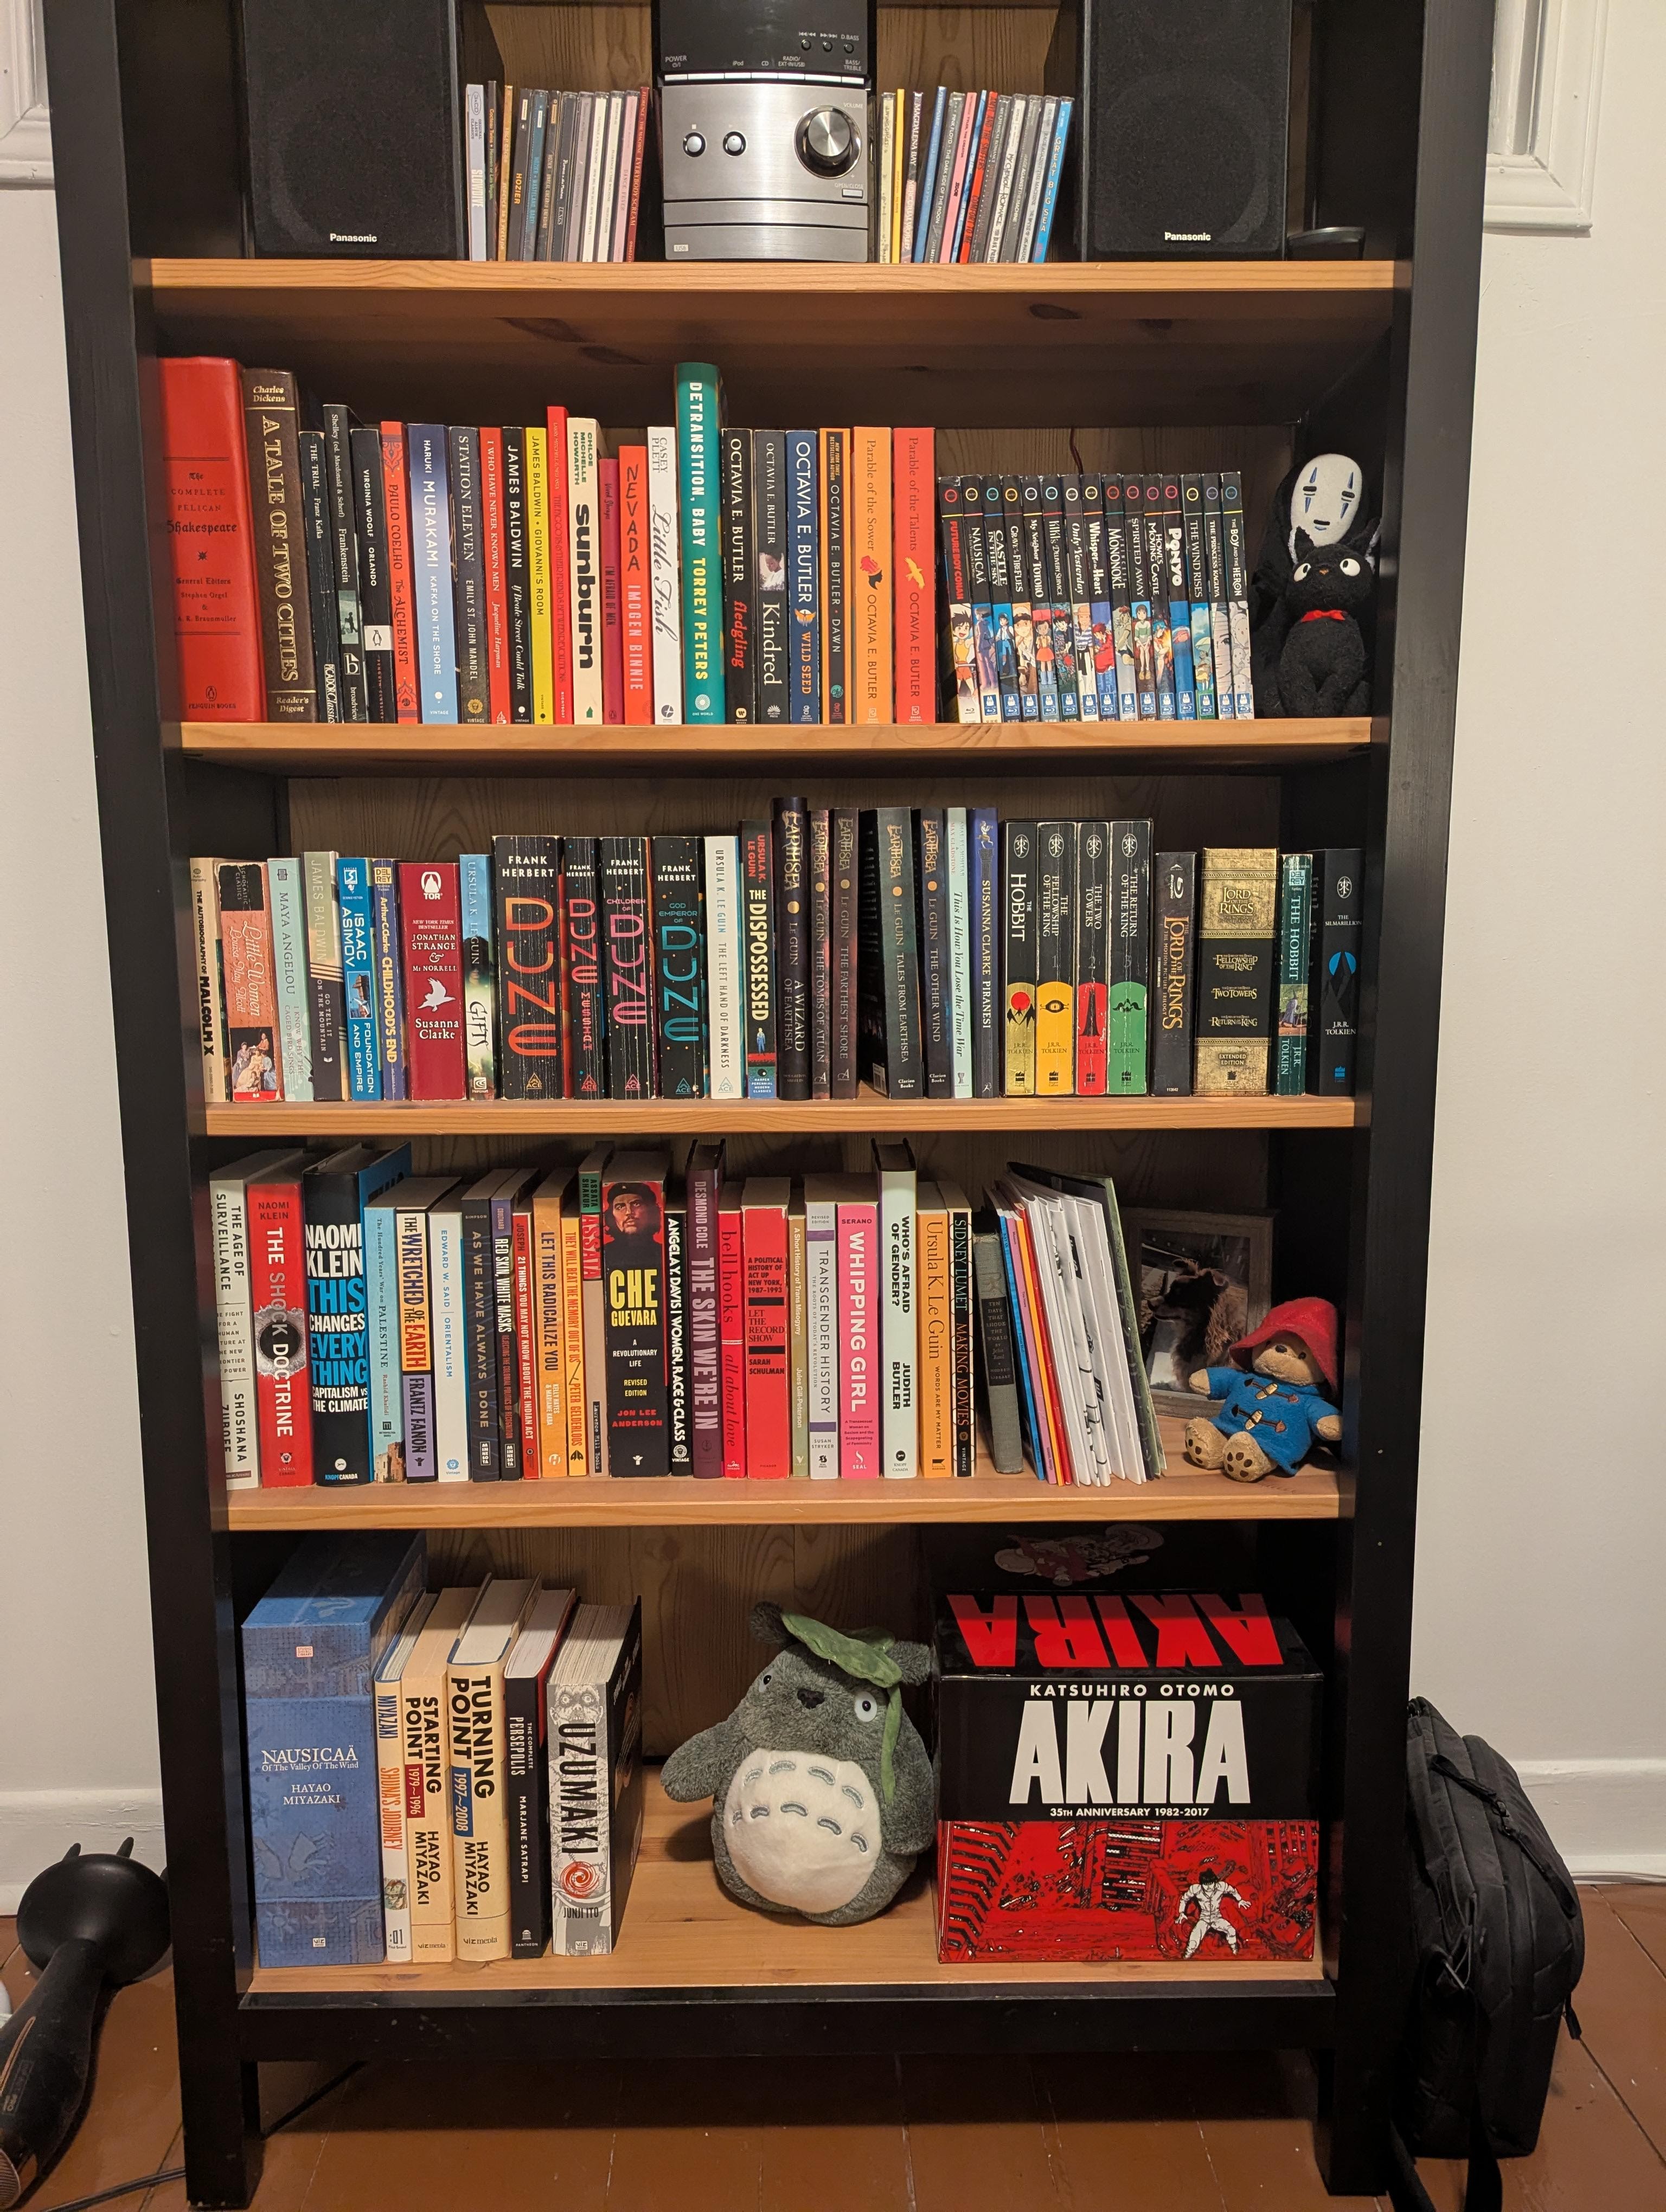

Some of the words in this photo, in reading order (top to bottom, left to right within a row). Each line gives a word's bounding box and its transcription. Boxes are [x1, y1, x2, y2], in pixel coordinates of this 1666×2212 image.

[912, 104, 921, 150] MAGDALENA
[1051, 137, 1061, 176] GREAT
[471, 169, 483, 208] SLOWDIVE
[514, 173, 522, 204] HOZIER
[632, 157, 641, 197] EVERYBODY
[1046, 181, 1054, 204] BIG
[329, 233, 377, 242] Panasonic
[1041, 208, 1049, 232] SEA
[1164, 232, 1212, 241] Panasonic
[262, 415, 280, 434] A
[689, 382, 704, 501] DETRANSITION,
[264, 440, 284, 504] TALE
[310, 443, 319, 462] THE
[424, 440, 432, 473] HARUKI
[459, 436, 472, 500] STATION
[652, 438, 660, 473] PLETT
[660, 438, 668, 473] CASEY
[908, 438, 919, 476] Parable
[312, 465, 321, 489] TRIAL
[363, 469, 372, 505] VIRGINIA
[909, 480, 919, 490] of
[313, 498, 323, 516] Franz
[389, 484, 400, 523] PAULO
[626, 466, 640, 571] NEVADA
[909, 493, 919, 511] the
[270, 509, 287, 538] OF
[315, 519, 324, 538] Kafka
[366, 509, 374, 537] WOOLF
[424, 480, 438, 568] MURAKAMI
[461, 504, 474, 562] ELEVEN
[692, 509, 706, 546] BABY
[909, 515, 919, 550] Talents
[1031, 519, 1038, 530] My
[1132, 518, 1141, 565] SPIRITED
[338, 528, 351, 583] Frankenstein
[392, 526, 402, 570] COELHO
[1031, 532, 1040, 560] Neighbor
[272, 543, 290, 599] TWO
[368, 547, 377, 586] ORLANDO
[1033, 561, 1043, 597] TOTORO
[1136, 567, 1144, 597] AWAY
[395, 580, 404, 593] The
[576, 504, 595, 669] sunburn
[693, 558, 707, 615] TORREY
[394, 596, 408, 665] ALCHEMIST
[627, 585, 641, 641] IMOGEN
[277, 603, 298, 681] CITIES
[695, 622, 708, 680] PETERS
[730, 600, 747, 668] fledgling
[762, 602, 782, 685] Kindred
[801, 631, 810, 661] WILD
[832, 619, 841, 652] DAWN
[630, 645, 643, 690] BINNIE
[802, 665, 811, 694] SEED
[350, 687, 359, 721] broadview
[502, 869, 554, 877] HERBERT
[508, 856, 547, 864] FRANK
[280, 892, 290, 927] MAYA
[749, 890, 767, 899] THE
[982, 880, 991, 931] SUSANNA
[1011, 874, 1026, 941] HOBBIT
[243, 921, 262, 961] Little
[343, 906, 355, 967] ASIMOV
[355, 913, 366, 960] ISAAC
[982, 935, 991, 975] CLARKE
[283, 933, 294, 995] ANGELOU
[505, 897, 556, 1057] DUNE
[750, 904, 768, 1020] DISPOSSESSED
[200, 976, 213, 1041] MALCOLM
[248, 962, 265, 1016] Women
[382, 957, 394, 1035] CHILDHOOD'S
[983, 980, 991, 1028] PIRANESI
[204, 1045, 214, 1056] X
[386, 1038, 398, 1063] END
[1281, 1039, 1289, 1075] TOLKIEN
[267, 1227, 284, 1264] THE
[722, 1230, 736, 1264] bell
[892, 1223, 899, 1241] OF
[610, 1270, 658, 1309] CHE
[849, 1231, 866, 1351] WHIPPING
[892, 1244, 900, 1306] GENDER?
[270, 1272, 289, 1335] SHOCK
[723, 1270, 738, 1323] hooks
[819, 1250, 830, 1350] TRANSGENDER
[379, 1306, 388, 1368] PALESTINE
[611, 1311, 657, 1326] GUEVARA
[445, 1318, 453, 1377] ORIENTALISM
[273, 1343, 292, 1437] DOCTRINE
[409, 1378, 424, 1414] FRANTZ
[820, 1355, 830, 1413] HISTORY
[851, 1356, 867, 1412] GIRL
[234, 1393, 247, 1462] SHOSHANA
[411, 1418, 426, 1453] FANON
[947, 1593, 1284, 1668] AKIRA
[1030, 1684, 1148, 1696] KATSUHIRO
[1160, 1684, 1234, 1696] OTOMO
[406, 1697, 421, 1759] POINT
[451, 1677, 471, 1760] POINT
[472, 1675, 495, 1799] TURNING
[262, 1745, 358, 1764] NAUSICAÄ
[423, 1696, 441, 1793] STARTING
[509, 1717, 526, 1776] PERSEPOLIS
[1009, 1700, 1251, 1804] AKIRA
[291, 1763, 311, 1772] Valley
[324, 1762, 337, 1770] The
[339, 1761, 359, 1770] Wind
[283, 1795, 341, 1805] MIYAZAKI
[291, 1784, 331, 1792] HAYAO
[381, 1767, 400, 1806] SHUNA'S
[558, 1722, 599, 1854] UZUMAKI
[383, 1808, 402, 1850] JOURNEY
[1050, 1808, 1073, 1817] 35TH
[1076, 1808, 1151, 1817] ANNIVERSARY
[1155, 1807, 1209, 1817] 1982-2017
